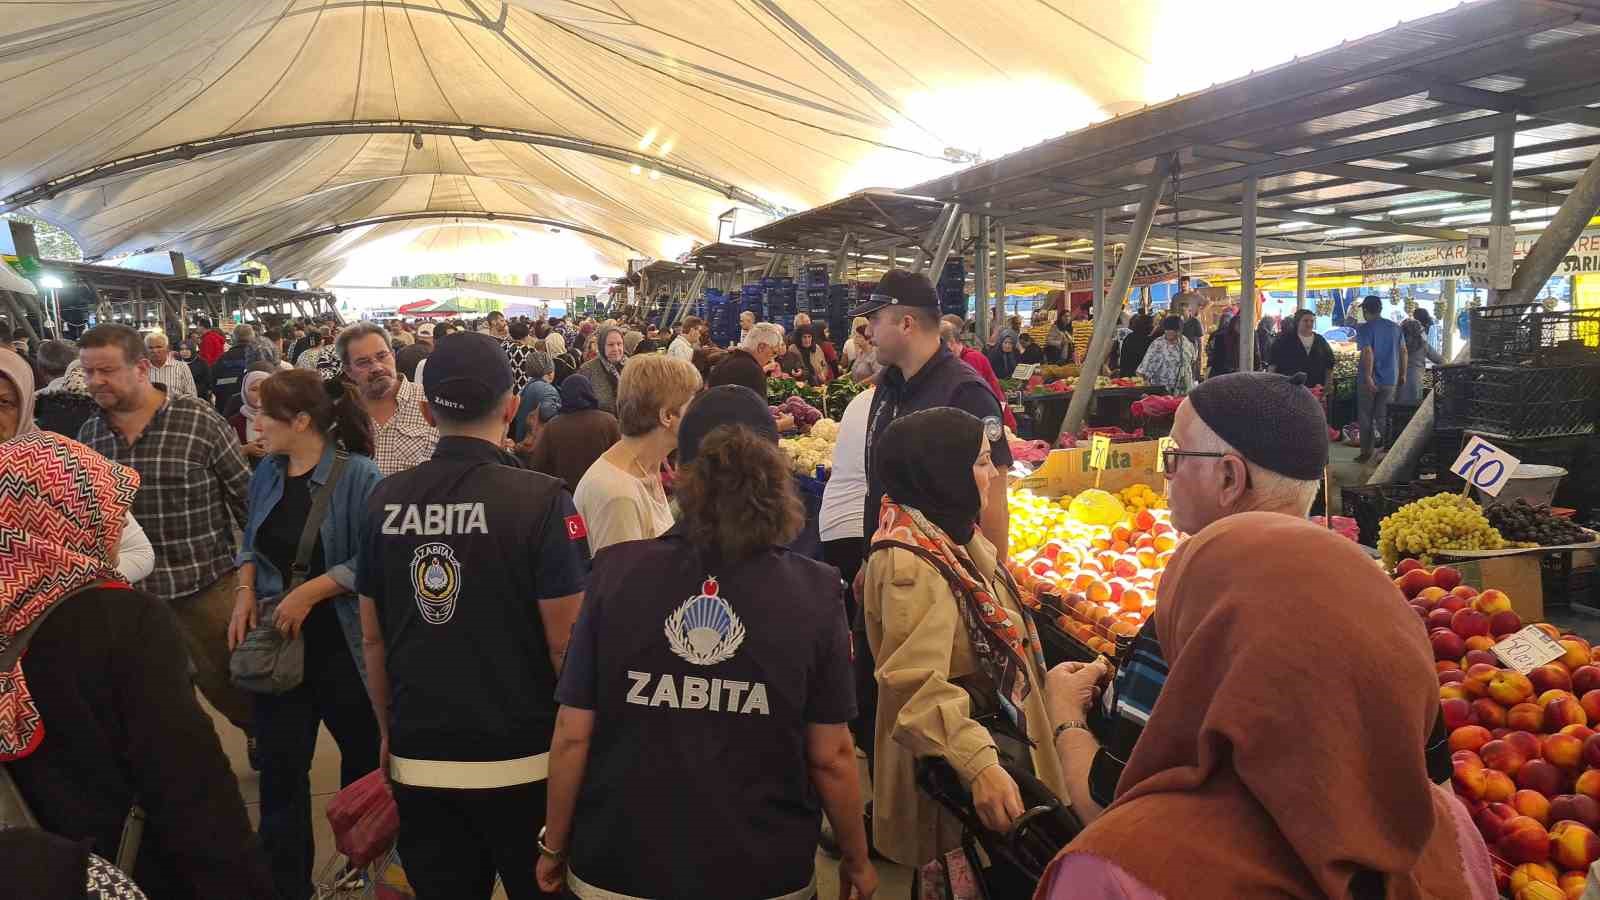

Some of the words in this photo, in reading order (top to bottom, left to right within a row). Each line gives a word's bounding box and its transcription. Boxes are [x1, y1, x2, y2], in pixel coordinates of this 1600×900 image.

[1436, 244, 1467, 261] KAR
[1562, 255, 1600, 271] SARI
[382, 503, 488, 535] ZABITA
[419, 545, 450, 559] ZABITA
[626, 670, 770, 715] ZABITA
